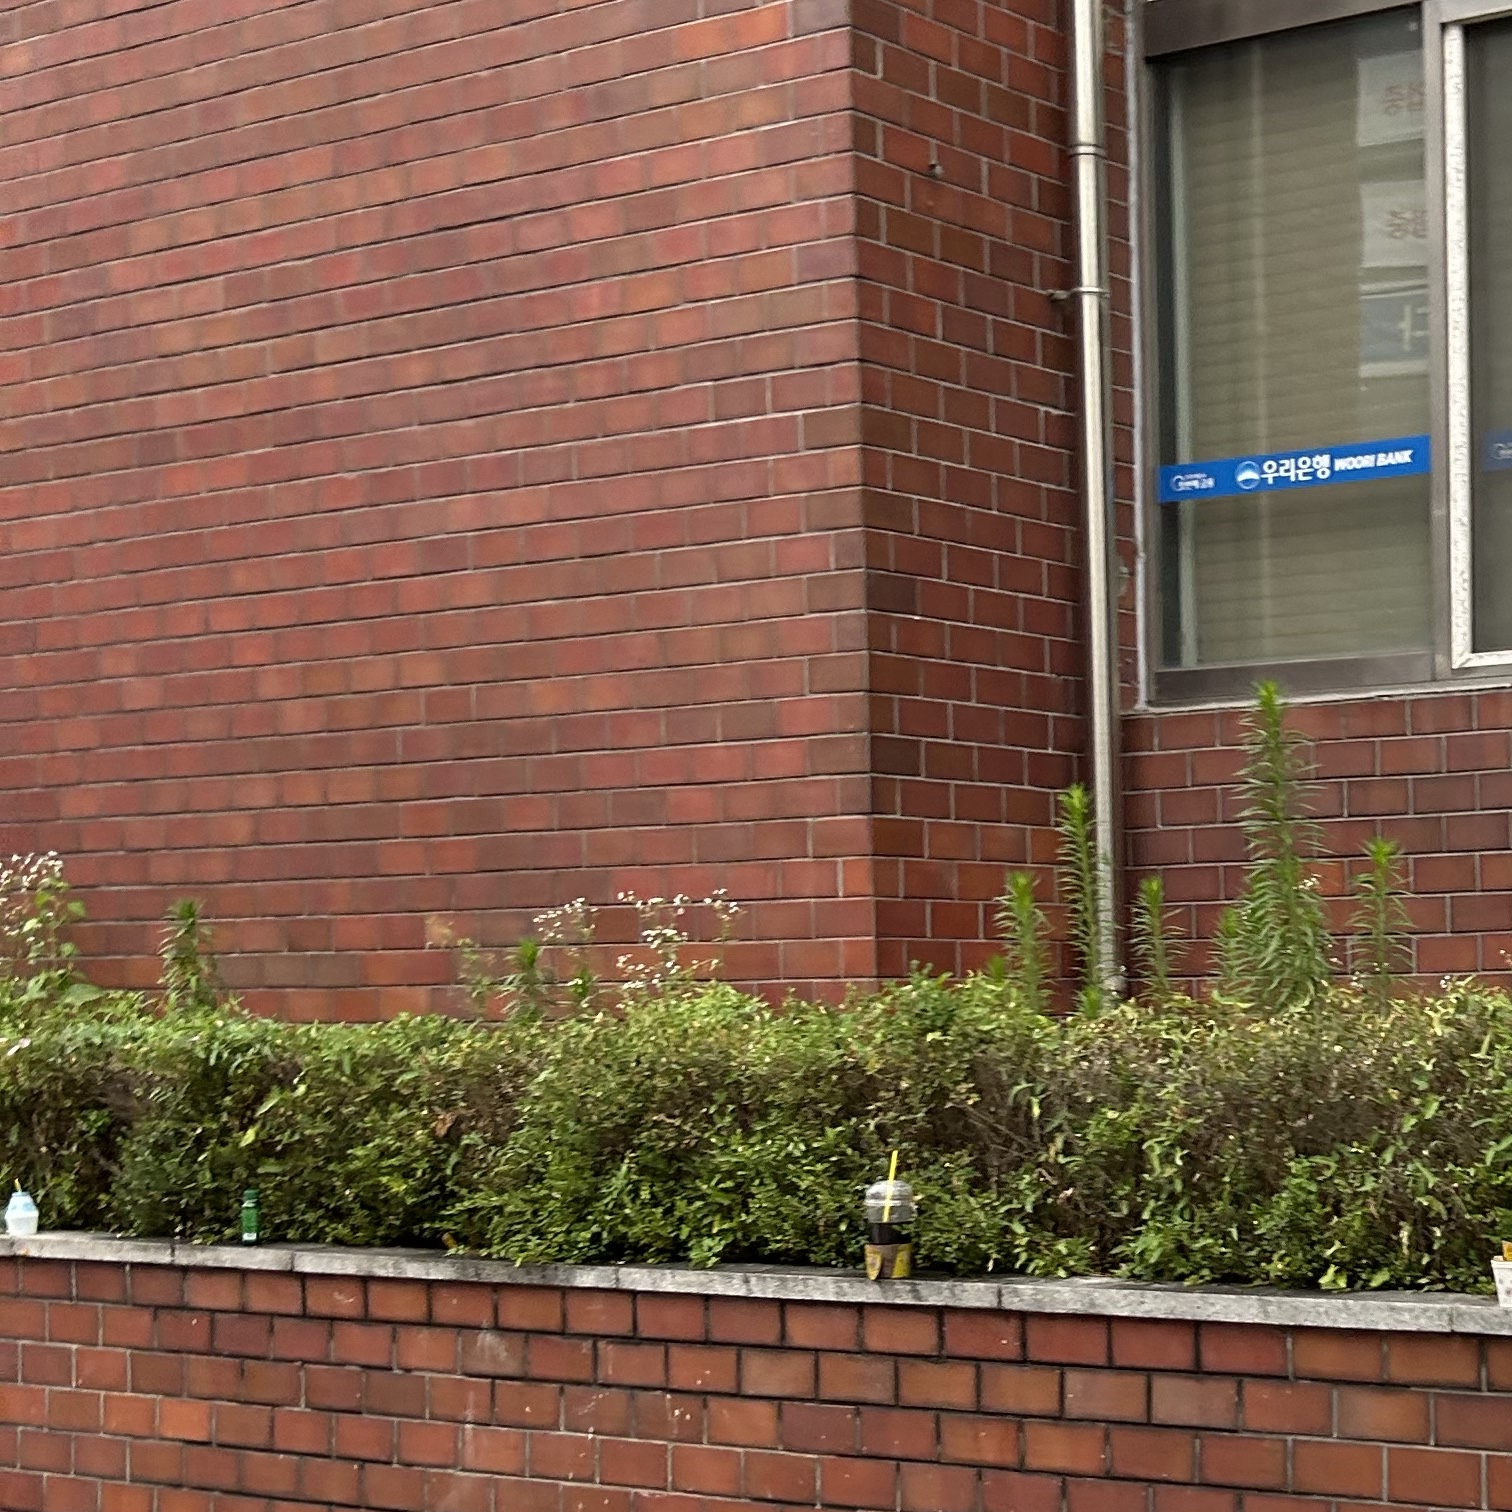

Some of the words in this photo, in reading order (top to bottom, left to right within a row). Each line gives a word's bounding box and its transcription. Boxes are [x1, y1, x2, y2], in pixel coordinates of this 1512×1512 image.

[1261, 454, 1331, 485] 우리은행
[1334, 455, 1376, 472] WOORI
[1376, 449, 1414, 467] BANK
